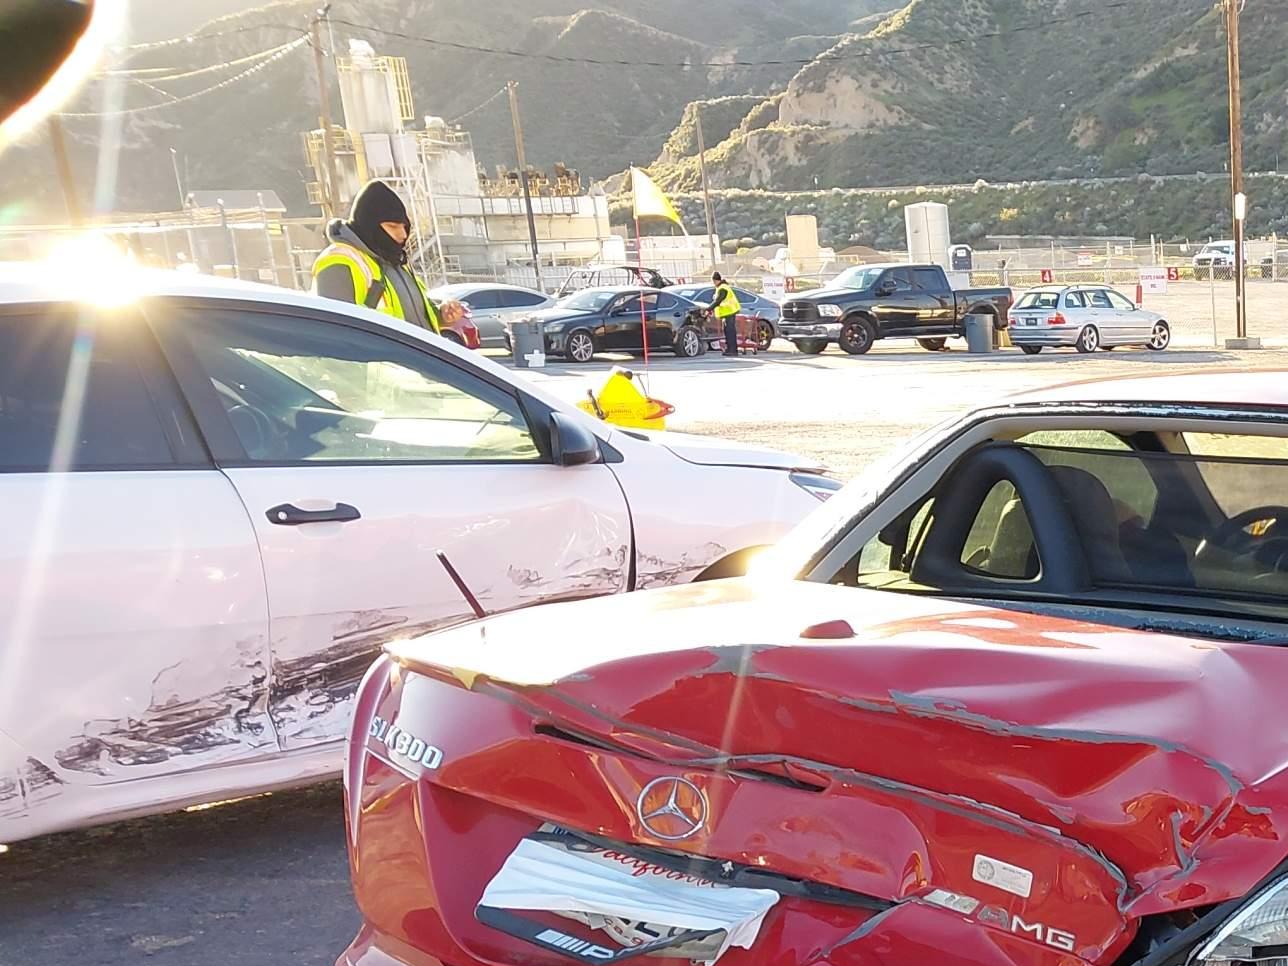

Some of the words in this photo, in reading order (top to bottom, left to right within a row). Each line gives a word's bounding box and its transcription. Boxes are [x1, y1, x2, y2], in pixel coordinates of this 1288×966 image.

[1042, 270, 1051, 282] 4
[1169, 267, 1178, 280] 5
[786, 277, 795, 291] 2
